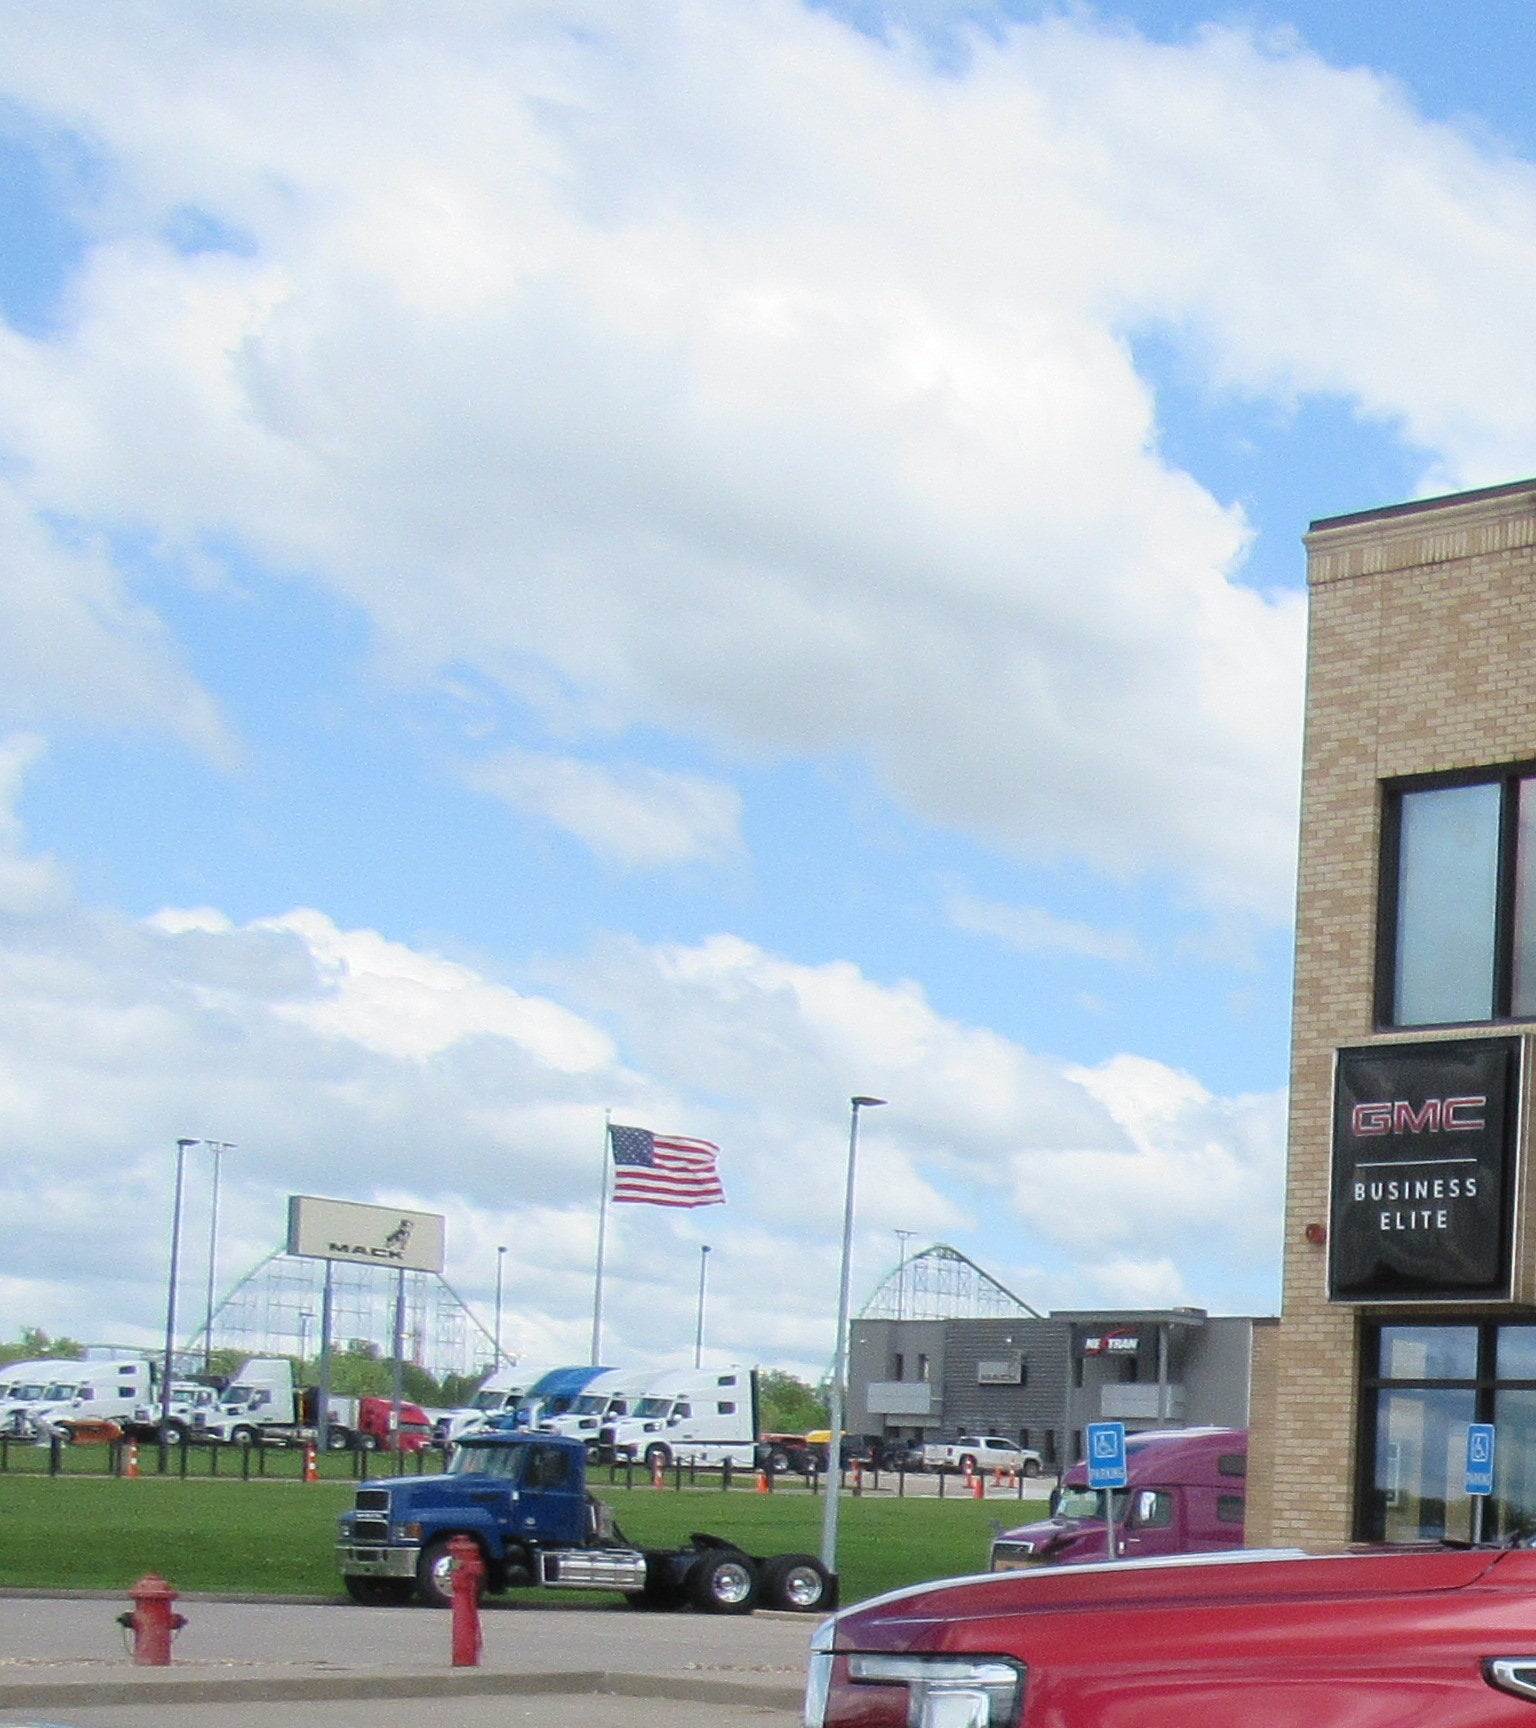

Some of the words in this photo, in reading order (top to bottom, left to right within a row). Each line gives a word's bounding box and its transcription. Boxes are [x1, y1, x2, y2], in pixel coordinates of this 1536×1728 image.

[1352, 1095, 1487, 1137] GMC
[1354, 1178, 1478, 1201] BUSINESS
[1380, 1209, 1448, 1231] ELITE
[329, 1241, 405, 1260] MACK
